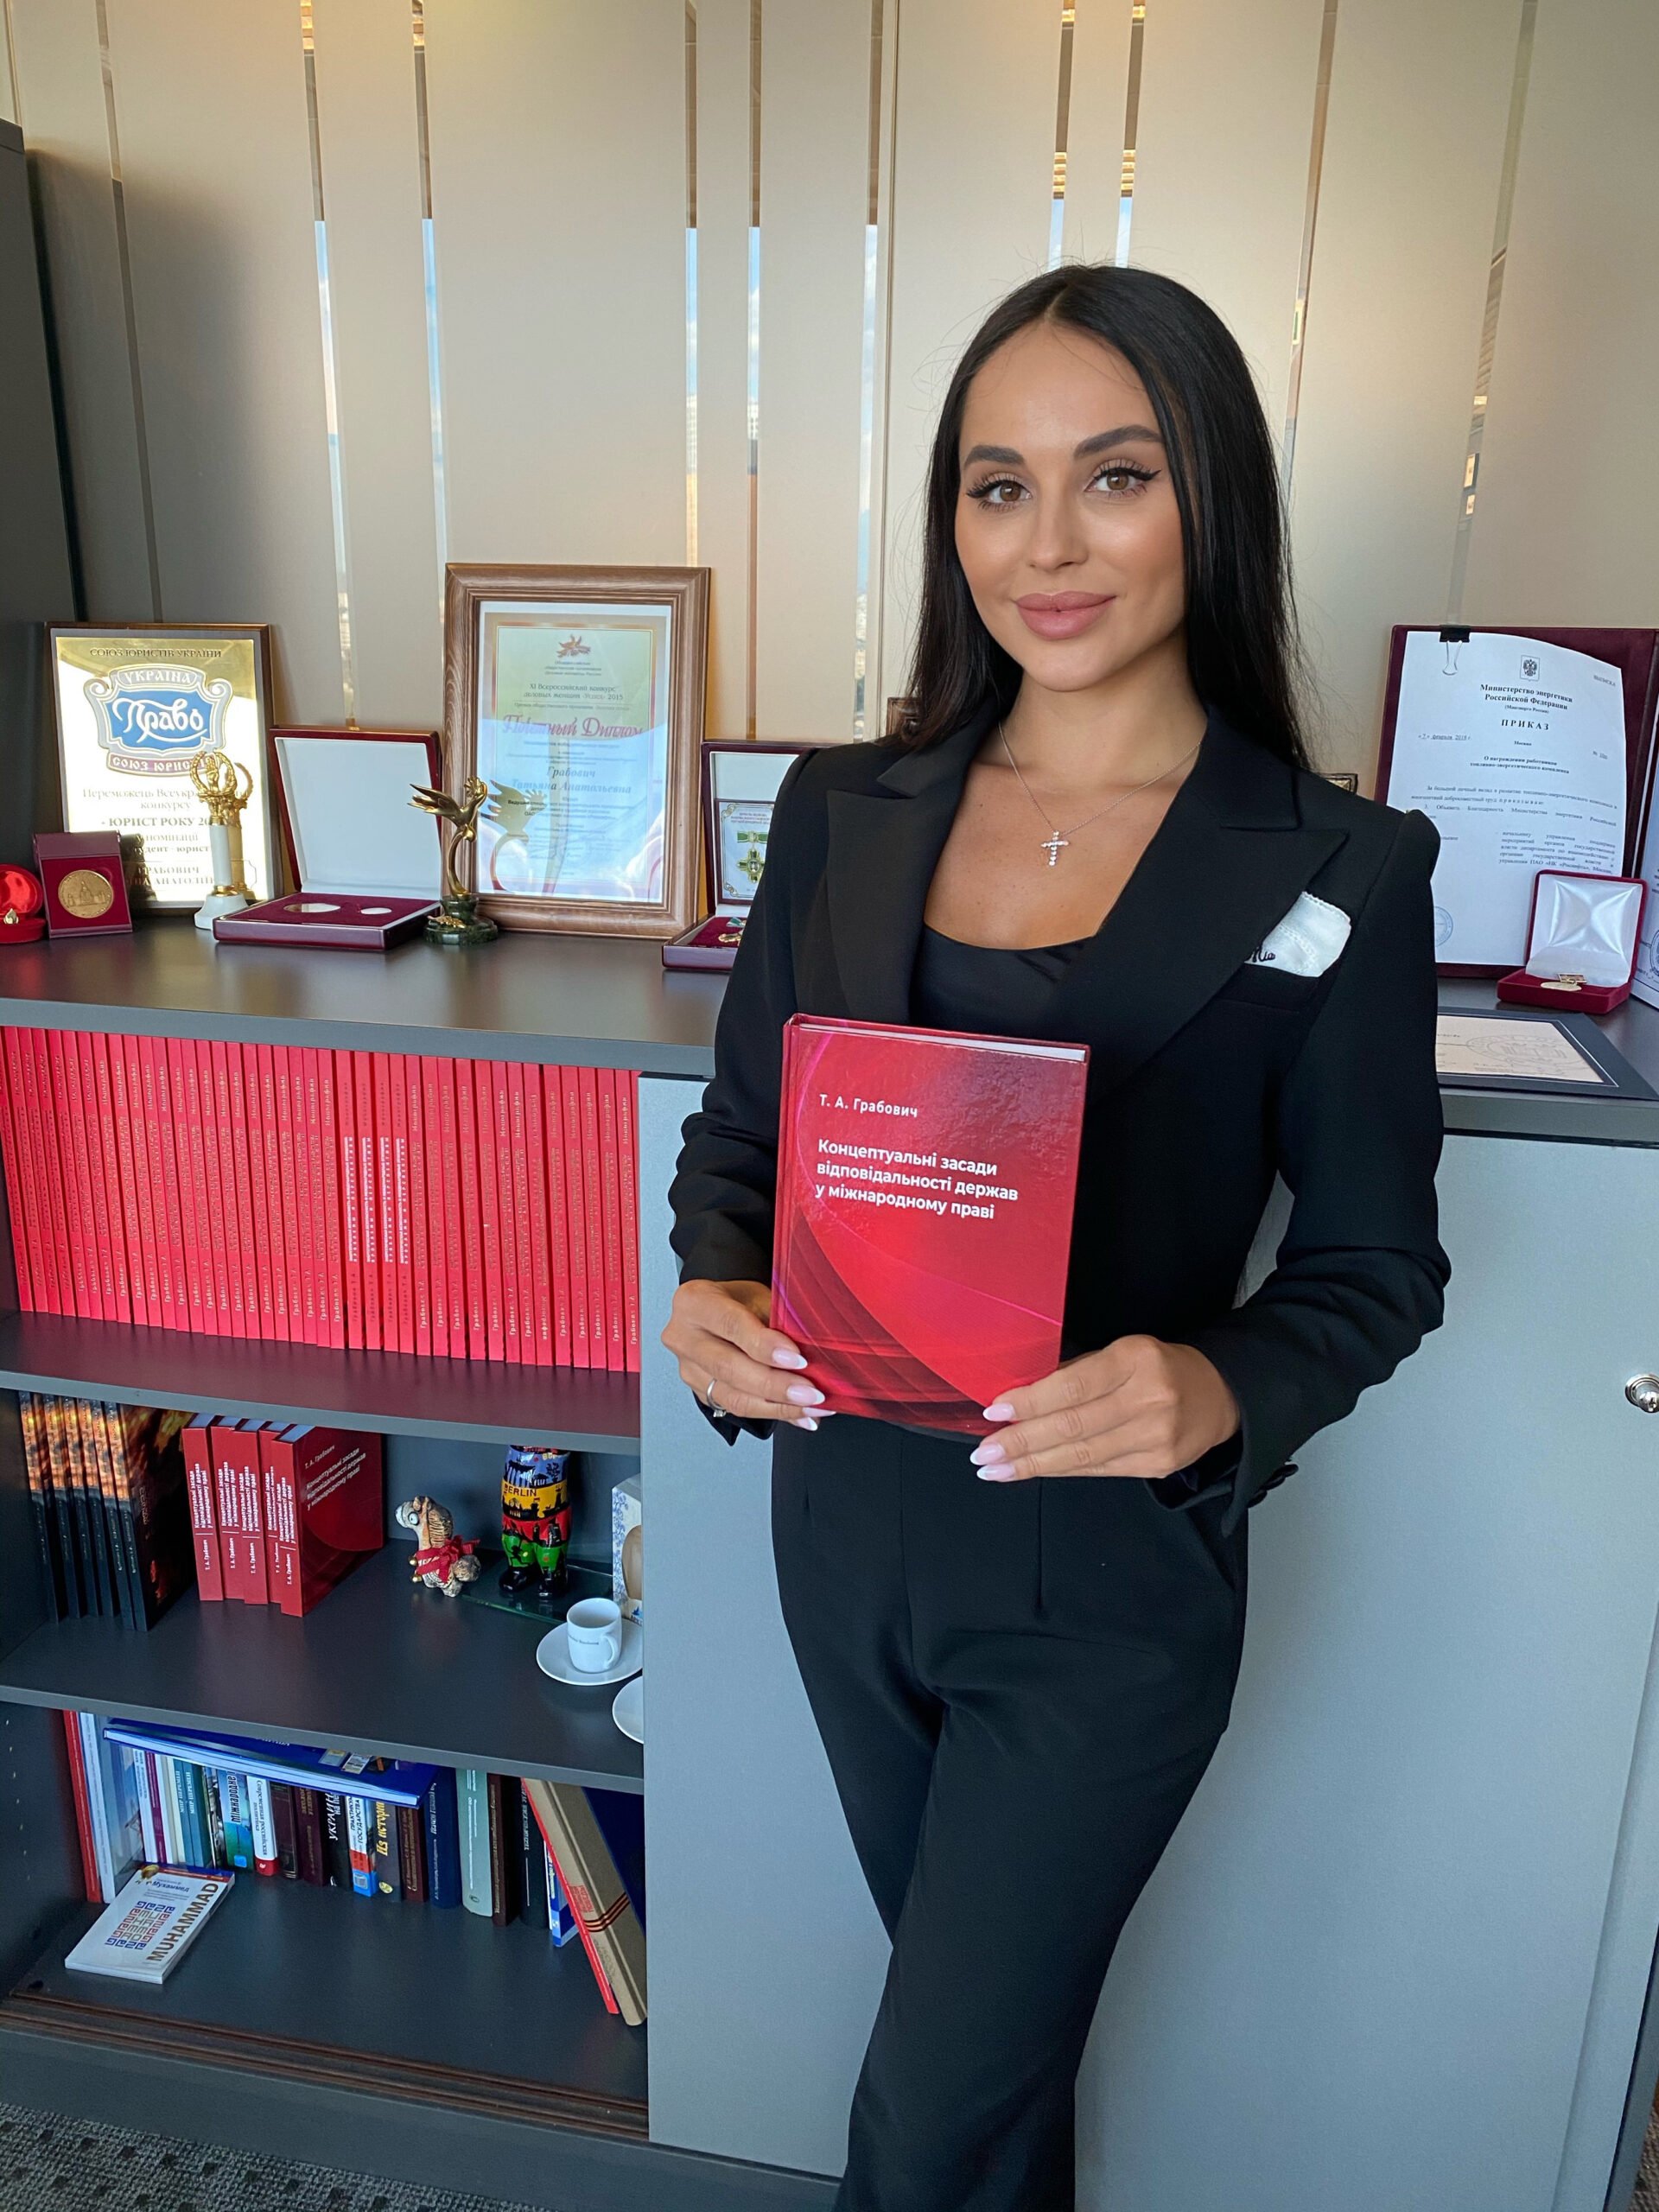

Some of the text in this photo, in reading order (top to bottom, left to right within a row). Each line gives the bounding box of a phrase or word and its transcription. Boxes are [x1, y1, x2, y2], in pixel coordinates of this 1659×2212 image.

[1480, 683, 1573, 702] Министерство энергетики
[1484, 694, 1567, 710] Российской Федерации
[112, 698, 207, 743] Право
[582, 717, 644, 738] Диплом
[112, 757, 149, 772] СОЮЗ
[548, 766, 595, 778] Грабович
[109, 818, 157, 827] ЮРИСТ
[161, 817, 194, 827] РОКУ
[819, 1094, 918, 1118] Т. А. Грабович
[818, 1139, 997, 1176] Концептуальні засади
[817, 1160, 1019, 1201] відповідальності держав
[815, 1185, 995, 1219] у міжнародному праві
[504, 1484, 537, 1497] BERLIN
[256, 1780, 268, 1855] Современная российская
[377, 1840, 388, 1856] Из
[152, 1881, 190, 1892] Мухаммед
[146, 1883, 219, 1961] MUHAMMAD
